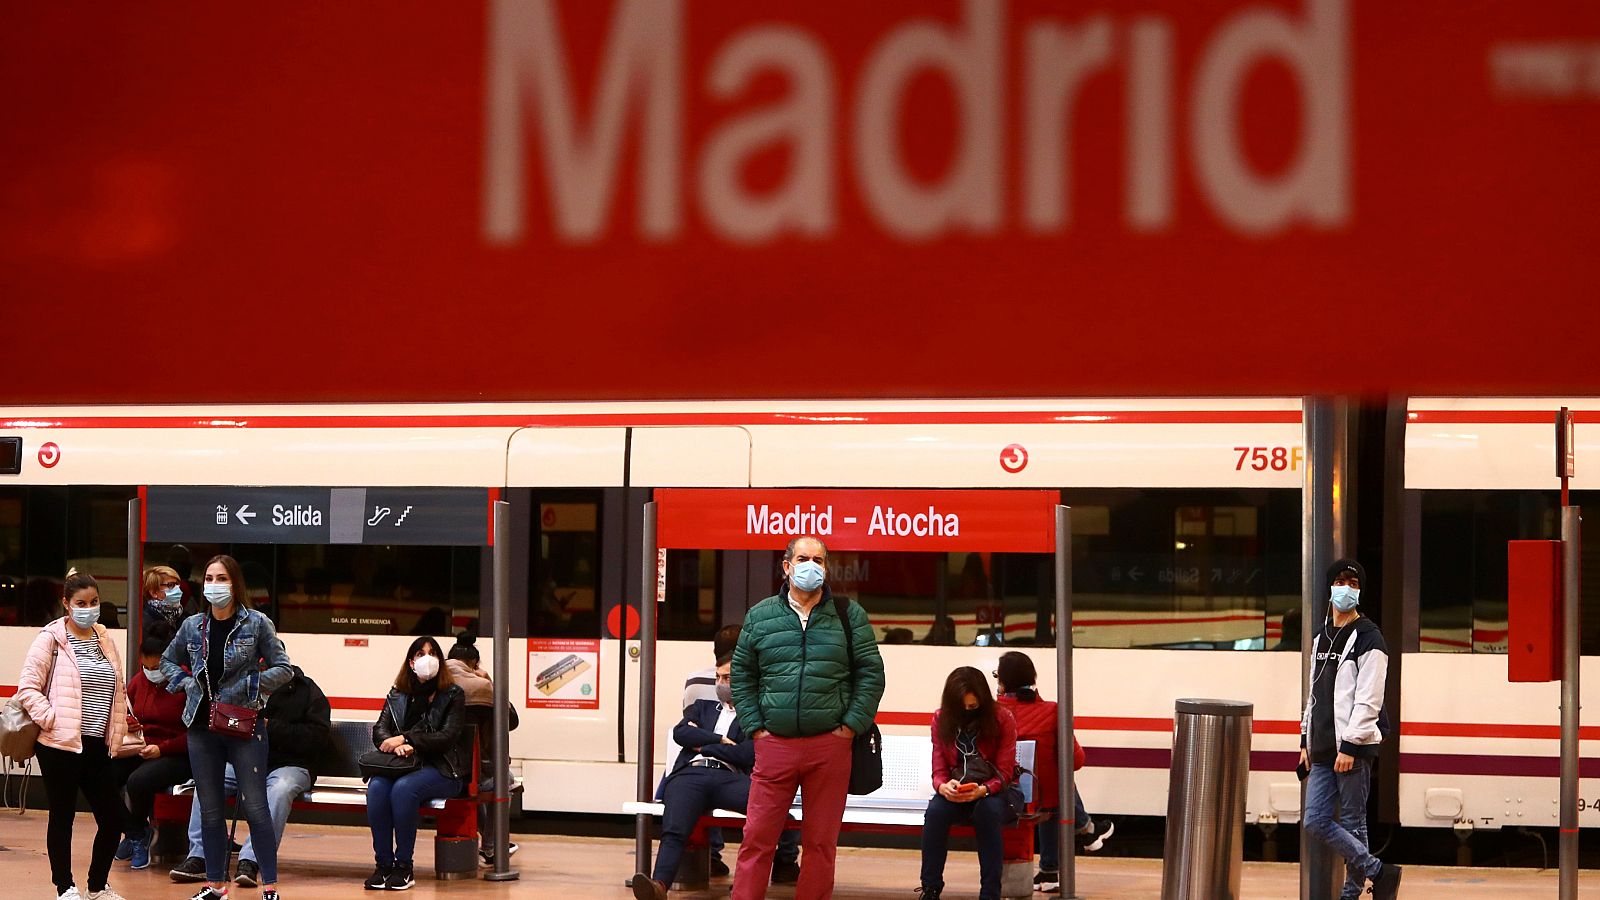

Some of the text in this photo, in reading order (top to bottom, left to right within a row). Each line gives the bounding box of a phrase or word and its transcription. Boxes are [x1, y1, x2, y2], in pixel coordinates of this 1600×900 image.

[481, 0, 1352, 245] Madrid
[272, 504, 322, 526] Salida
[746, 504, 833, 535] Madrid
[867, 505, 959, 536] Atocha
